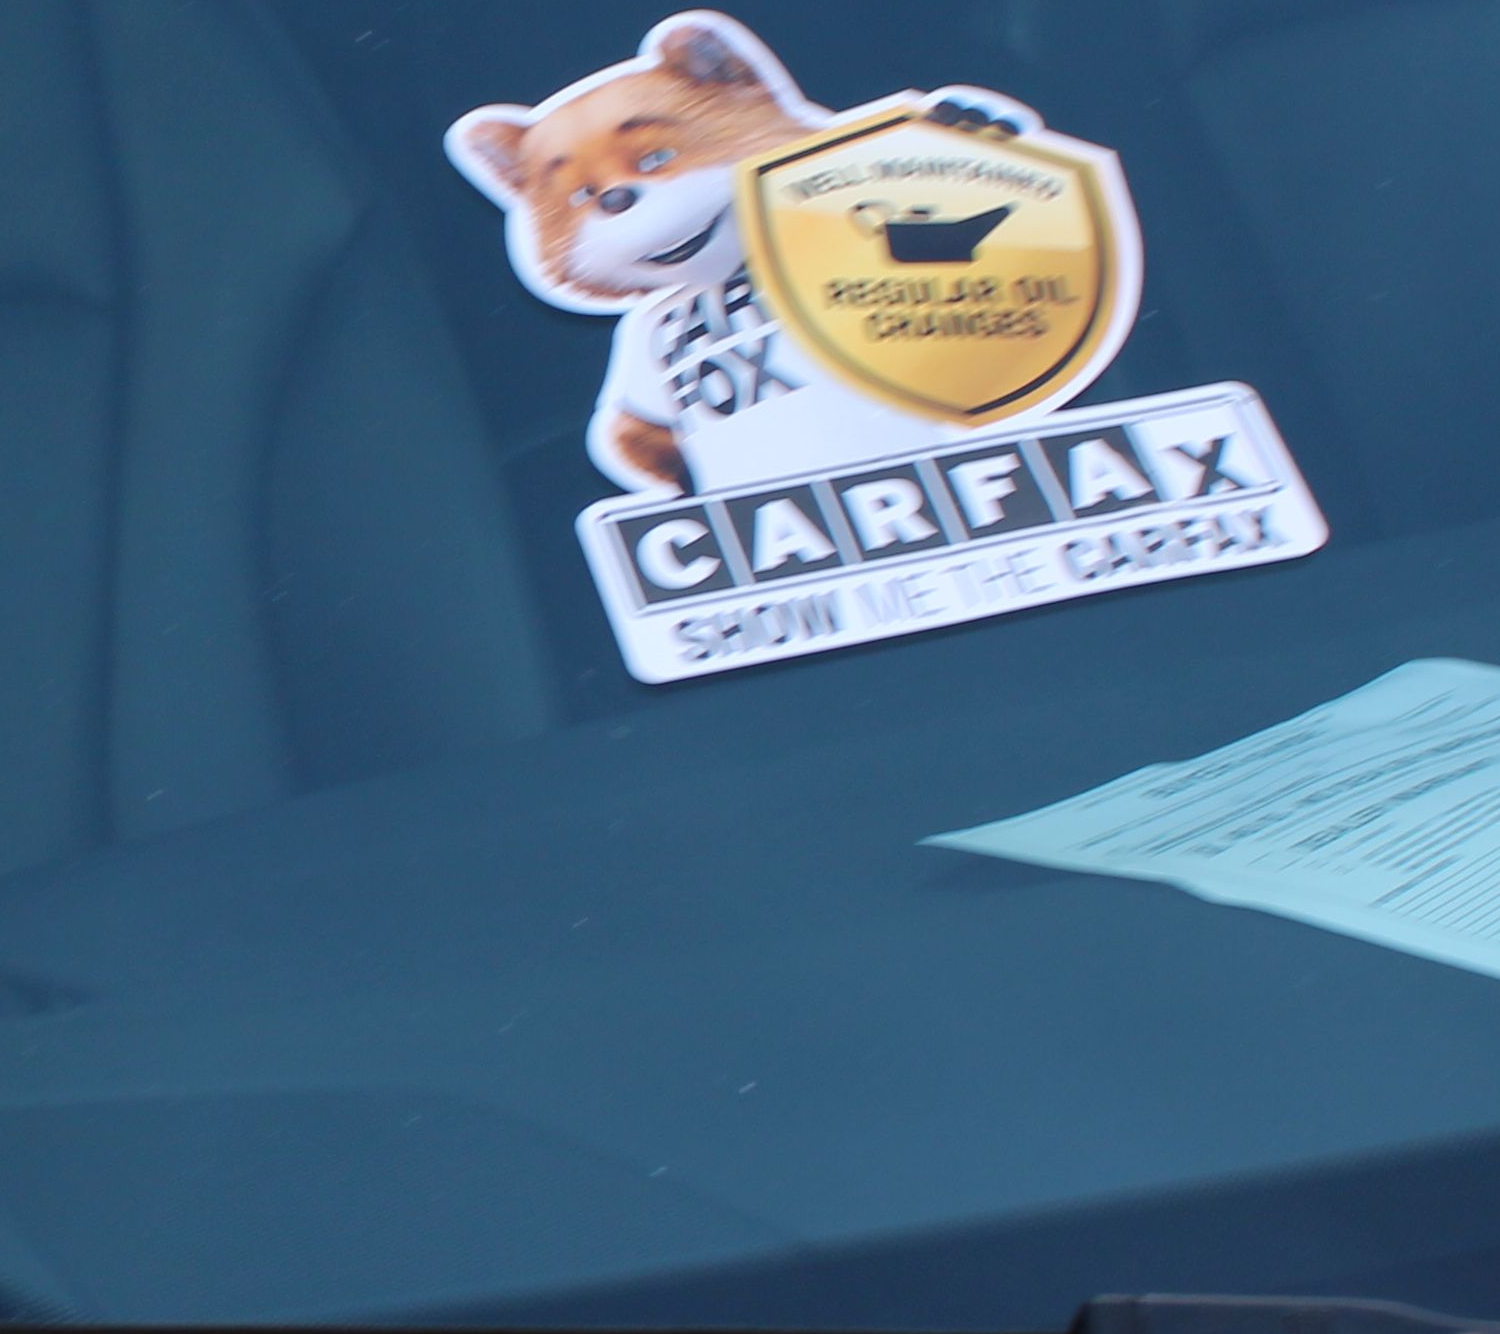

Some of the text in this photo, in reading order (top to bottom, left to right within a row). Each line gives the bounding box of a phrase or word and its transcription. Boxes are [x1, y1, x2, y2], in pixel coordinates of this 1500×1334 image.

[782, 165, 868, 204] WELL
[822, 273, 1080, 309] REGULAR OIL
[862, 307, 1048, 342] CHANGES
[635, 430, 1258, 591] CARFAX
[669, 503, 1294, 663] SHOW ME THE CARFAX
